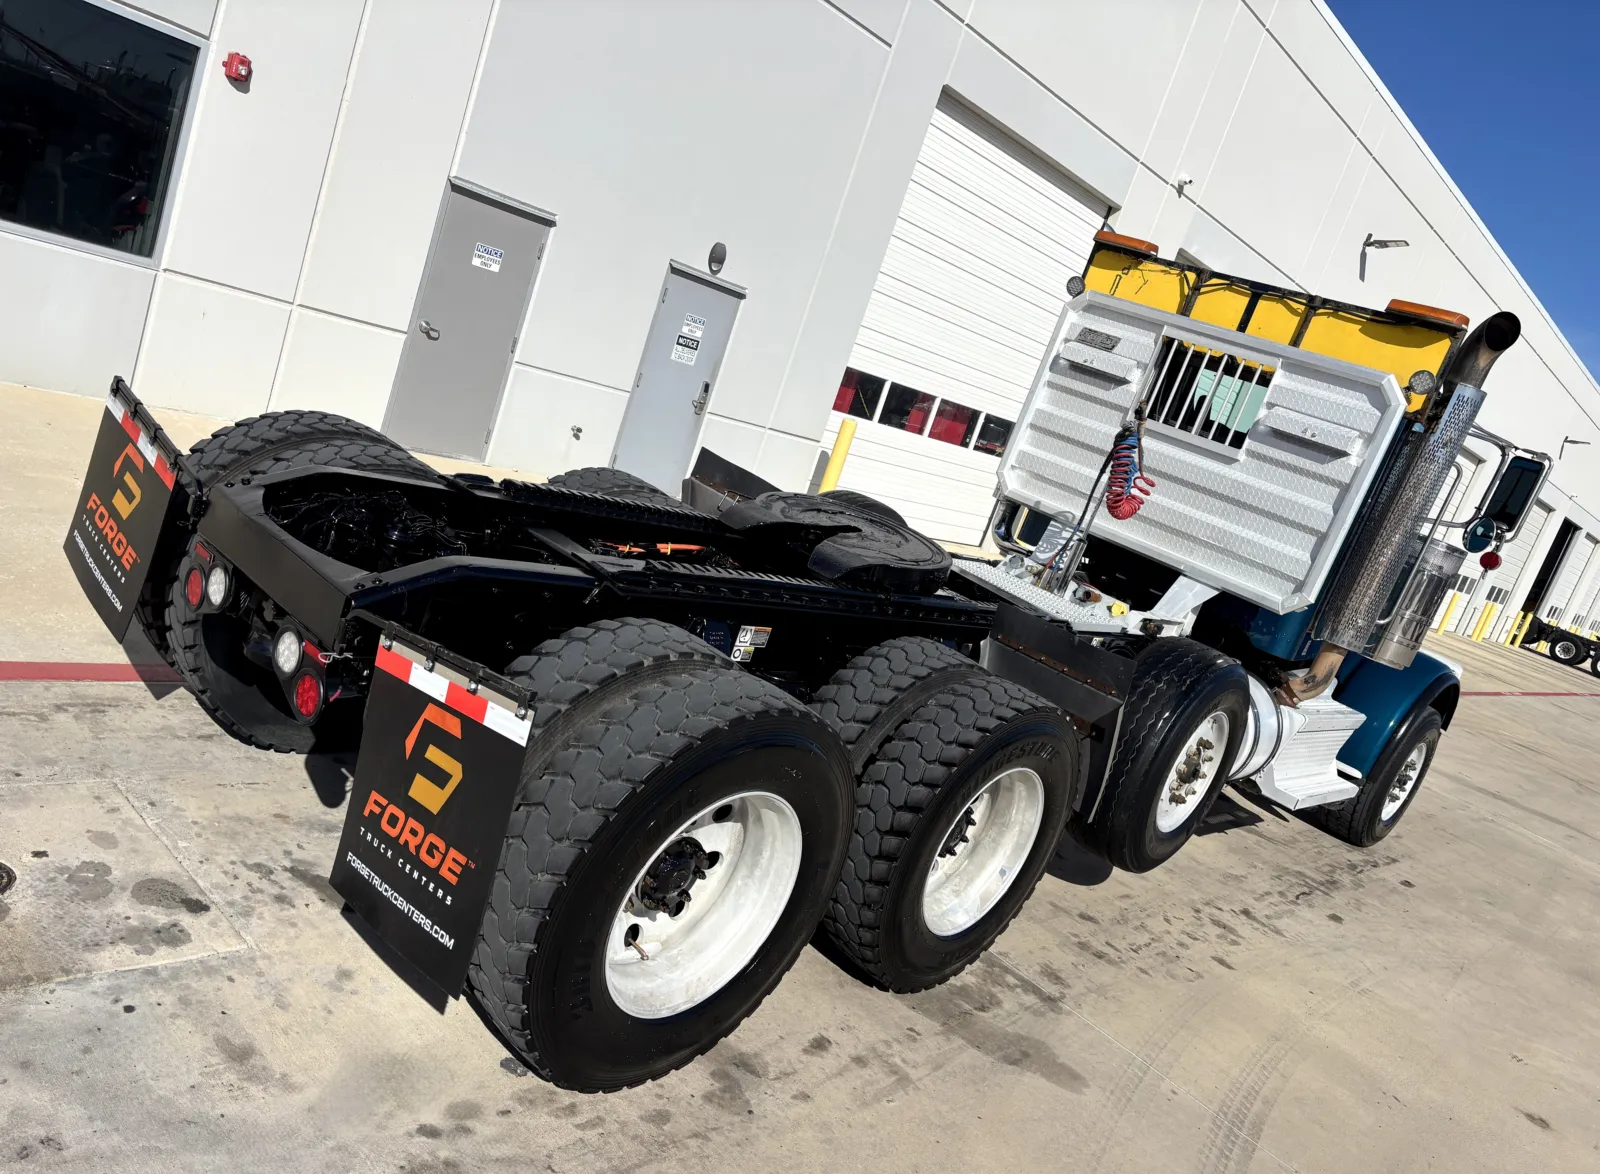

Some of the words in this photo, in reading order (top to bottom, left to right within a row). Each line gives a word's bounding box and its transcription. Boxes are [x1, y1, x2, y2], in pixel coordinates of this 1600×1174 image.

[474, 252, 501, 265] EMPLOYEES
[476, 244, 503, 259] NOTICE
[480, 260, 492, 268] ONLY
[685, 314, 705, 326] NOTICE
[678, 336, 699, 349] NOTICE
[83, 514, 98, 543] TRUCK
[99, 543, 126, 584] CENTERS
[73, 529, 123, 613] FORGETRUCKCENTERS.COM
[360, 826, 393, 860] TRUCK
[397, 858, 453, 906] CENTERS
[346, 851, 455, 950] FORGETRUCKCENTERS.COM
